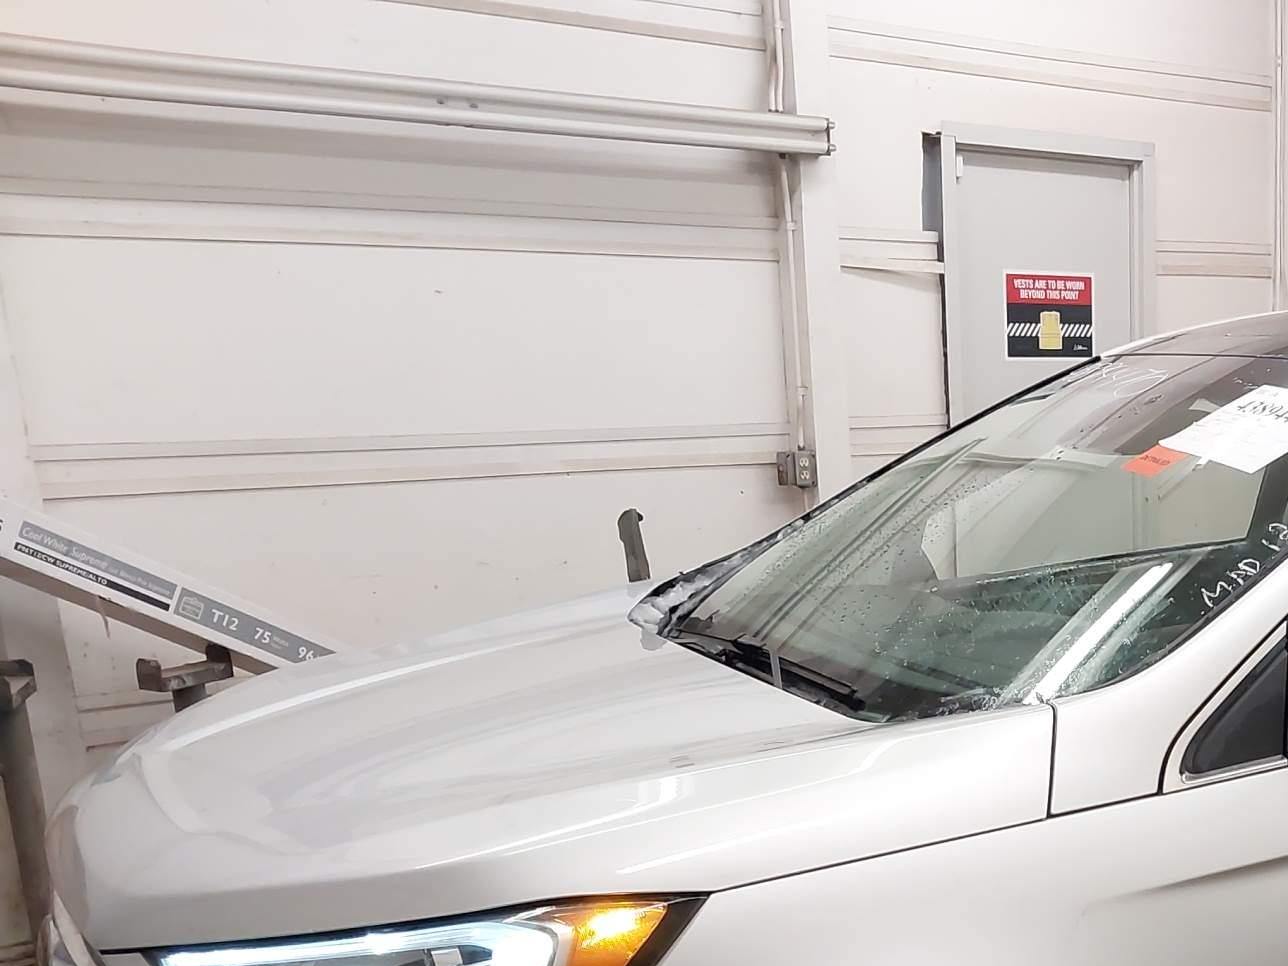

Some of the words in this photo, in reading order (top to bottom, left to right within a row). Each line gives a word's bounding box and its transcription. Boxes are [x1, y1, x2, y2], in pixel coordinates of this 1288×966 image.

[1013, 279, 1034, 289] VESTS
[1034, 279, 1048, 289] ARE
[1048, 280, 1057, 290] TO
[1057, 280, 1066, 290] BE
[1066, 281, 1085, 291] WORN
[1020, 289, 1046, 299] BEYOND
[1046, 290, 1061, 300] THIS
[1061, 290, 1079, 300] POINT
[70, 546, 109, 569] Supreme
[211, 608, 240, 631] T12
[254, 627, 273, 644] 75
